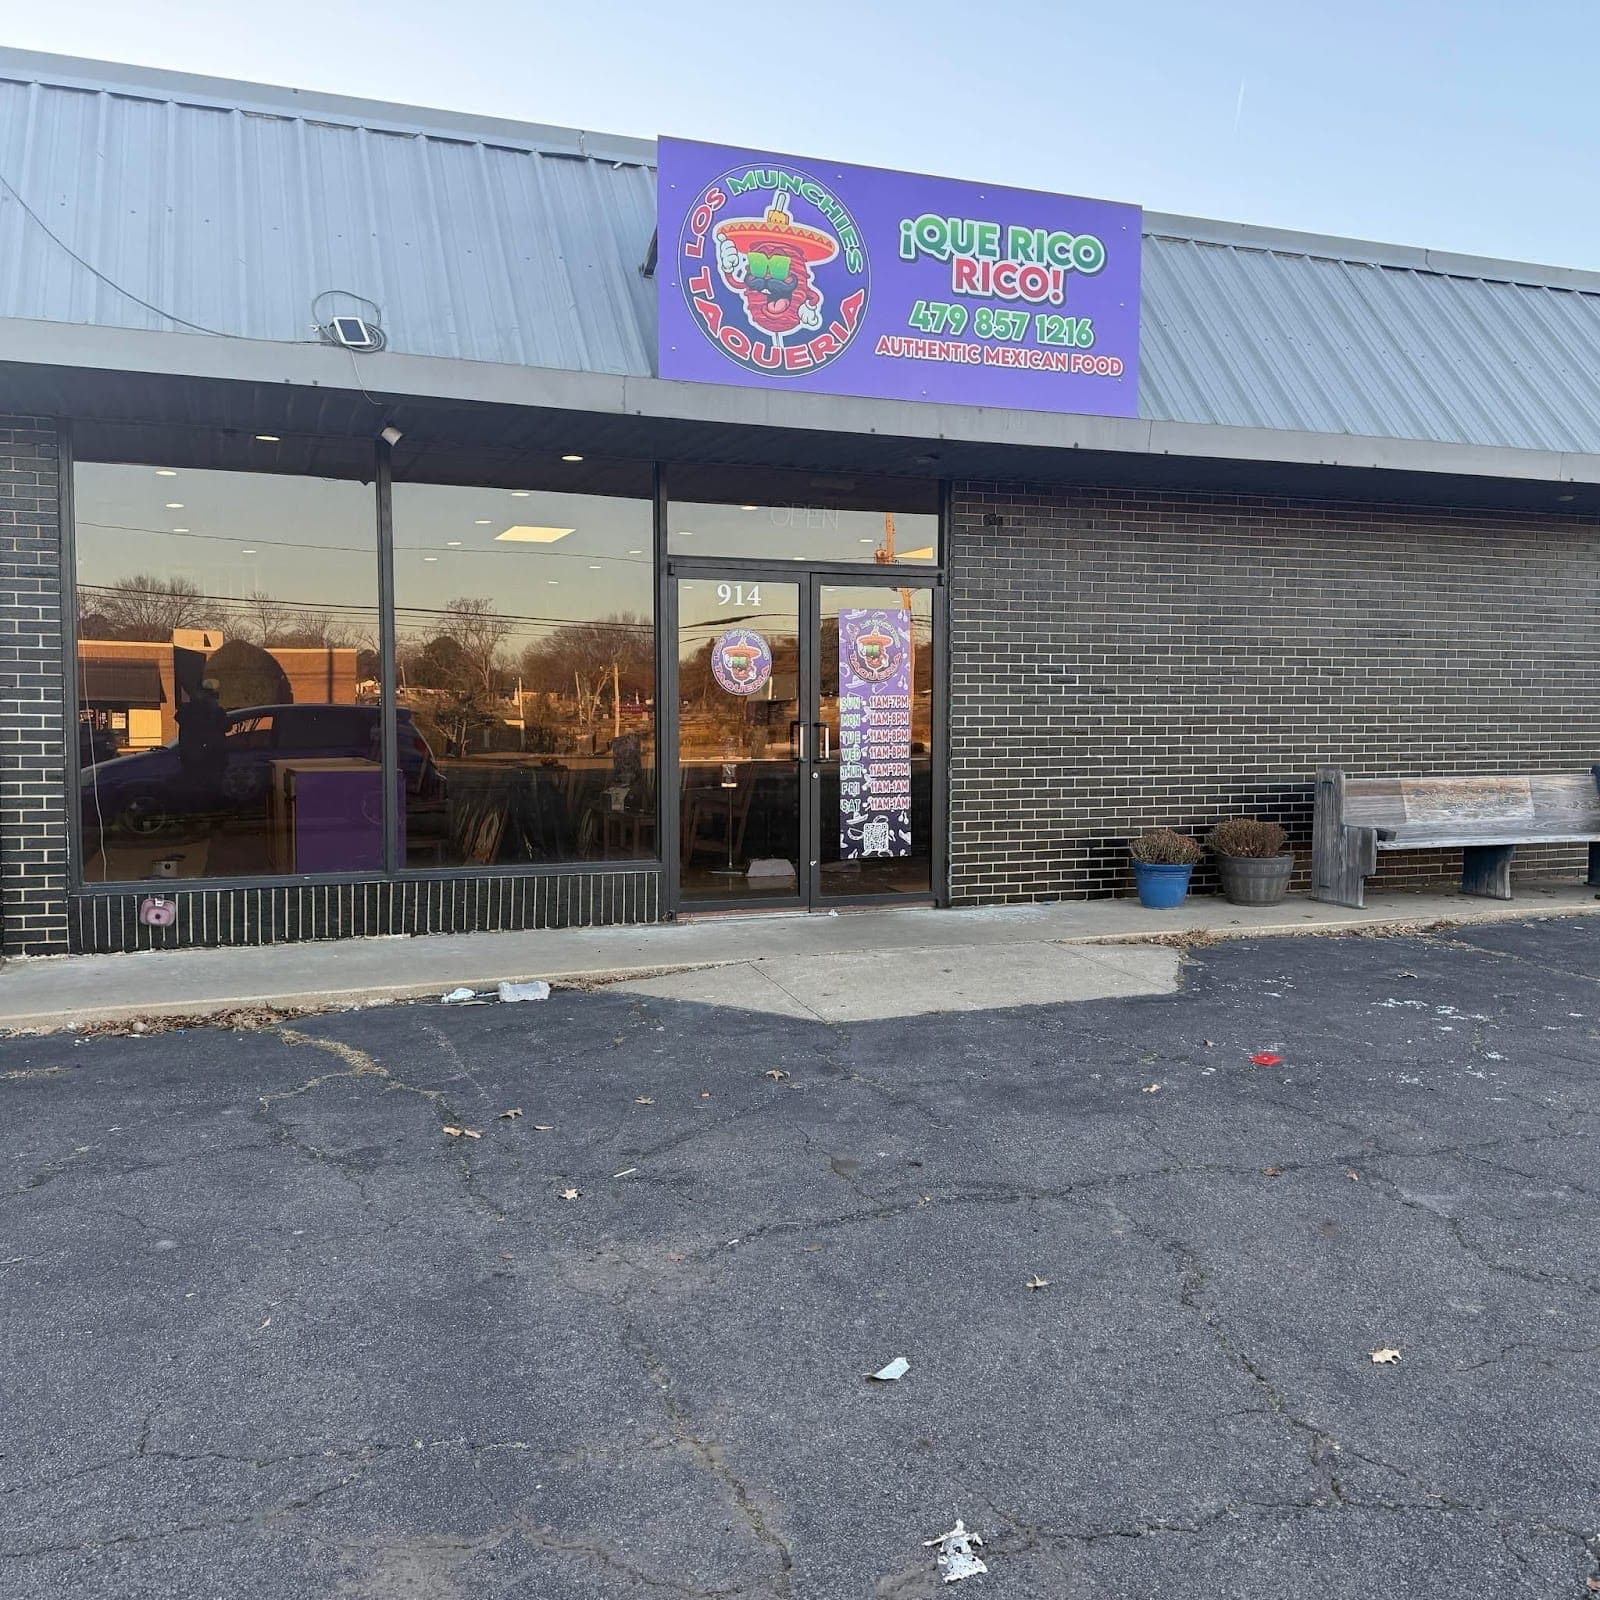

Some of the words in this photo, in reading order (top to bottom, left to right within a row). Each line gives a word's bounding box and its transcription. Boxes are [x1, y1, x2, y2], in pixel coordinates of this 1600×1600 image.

[685, 187, 727, 258] LOS
[726, 169, 863, 275] MUNCHIES
[1007, 225, 1106, 273] RICO
[952, 255, 1066, 305] RICO!
[689, 266, 865, 370] TAQUERIA
[908, 301, 968, 335] 479
[973, 307, 1031, 342] 857
[1035, 314, 1095, 348] 1216
[874, 335, 981, 364] AUTHENTIC
[984, 346, 1068, 372] MEXICAN
[1071, 354, 1125, 377] FOOD
[770, 500, 840, 530] OPEN
[717, 584, 762, 606] 914
[841, 697, 861, 710] SUN
[841, 713, 861, 726] MON
[841, 731, 861, 744] TUE
[842, 748, 861, 761] WED
[841, 765, 862, 777] THUR
[841, 782, 860, 794] FRI
[841, 799, 861, 812] SAT
